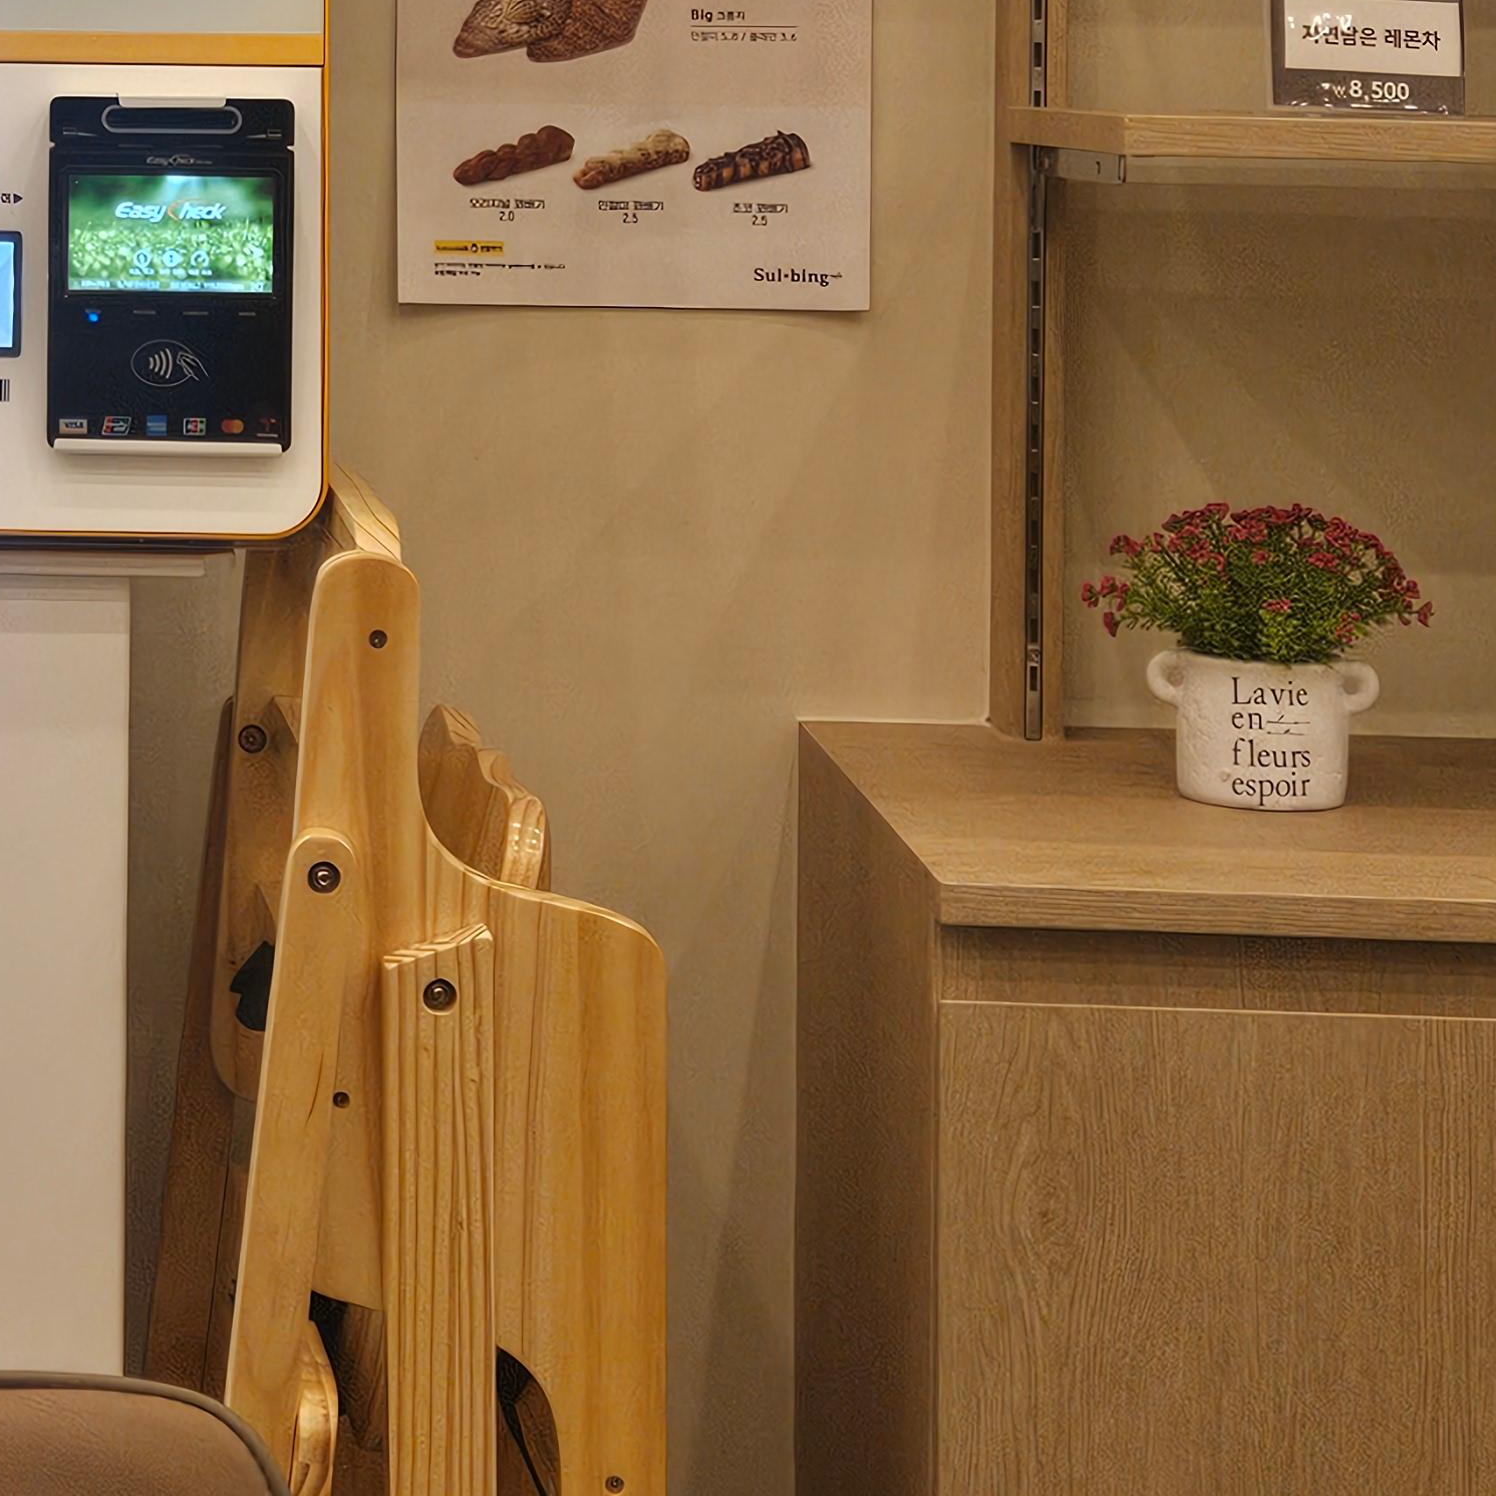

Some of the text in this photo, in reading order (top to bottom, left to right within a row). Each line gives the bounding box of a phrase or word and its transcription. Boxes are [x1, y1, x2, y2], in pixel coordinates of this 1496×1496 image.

[691, 8, 714, 22] Big
[1384, 28, 1442, 52] 레몬차
[499, 210, 515, 222] 2.0
[1231, 711, 1264, 730] en
[1232, 738, 1312, 768] fleurs
[1231, 771, 1312, 806] espoir
